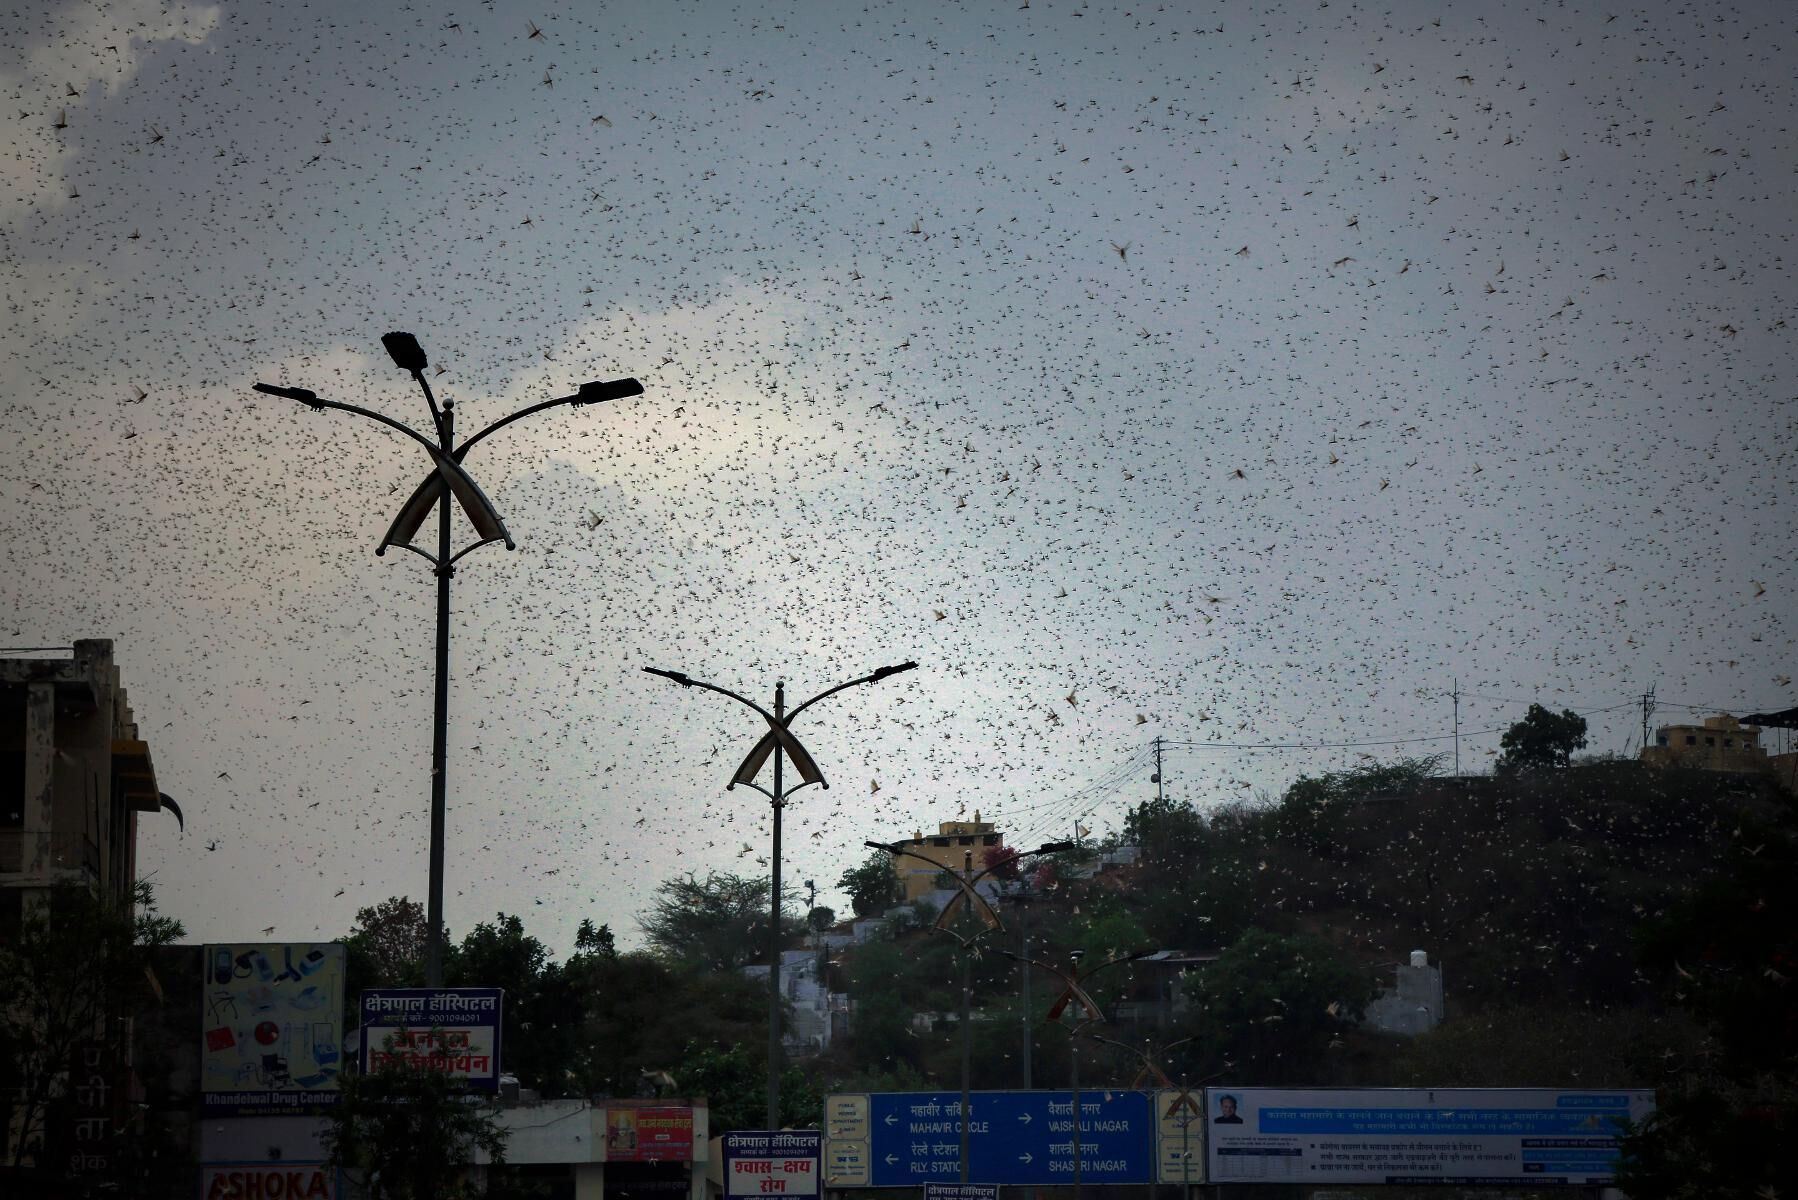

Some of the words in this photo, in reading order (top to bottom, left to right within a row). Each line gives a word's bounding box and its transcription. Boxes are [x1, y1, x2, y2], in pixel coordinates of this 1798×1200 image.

[365, 993, 427, 1012] क्षेत्रपाल
[428, 993, 497, 1012] हॉस्पिटल
[206, 1092, 271, 1105] Khandelwal
[272, 1092, 299, 1106] Drug
[300, 1091, 337, 1104] Center
[910, 1102, 940, 1117] महावीर
[1081, 1103, 1101, 1115] नगर
[910, 1122, 952, 1134] MAHAVIR
[955, 1122, 989, 1134] CCLE
[1094, 1120, 1129, 1132] NAGAR
[727, 1135, 770, 1148] क्षेत्रपाल
[771, 1134, 818, 1148] हॉस्पिटल
[932, 1141, 960, 1156] स्टेशन
[1049, 1140, 1075, 1155] शास्त्री
[1079, 1143, 1099, 1155] नगर
[931, 1161, 961, 1173] STATIO
[1048, 1160, 1090, 1172] SHASRI
[1093, 1160, 1127, 1172] NAGAR
[208, 1171, 329, 1200] ASHOKA
[760, 1176, 786, 1193] रोग
